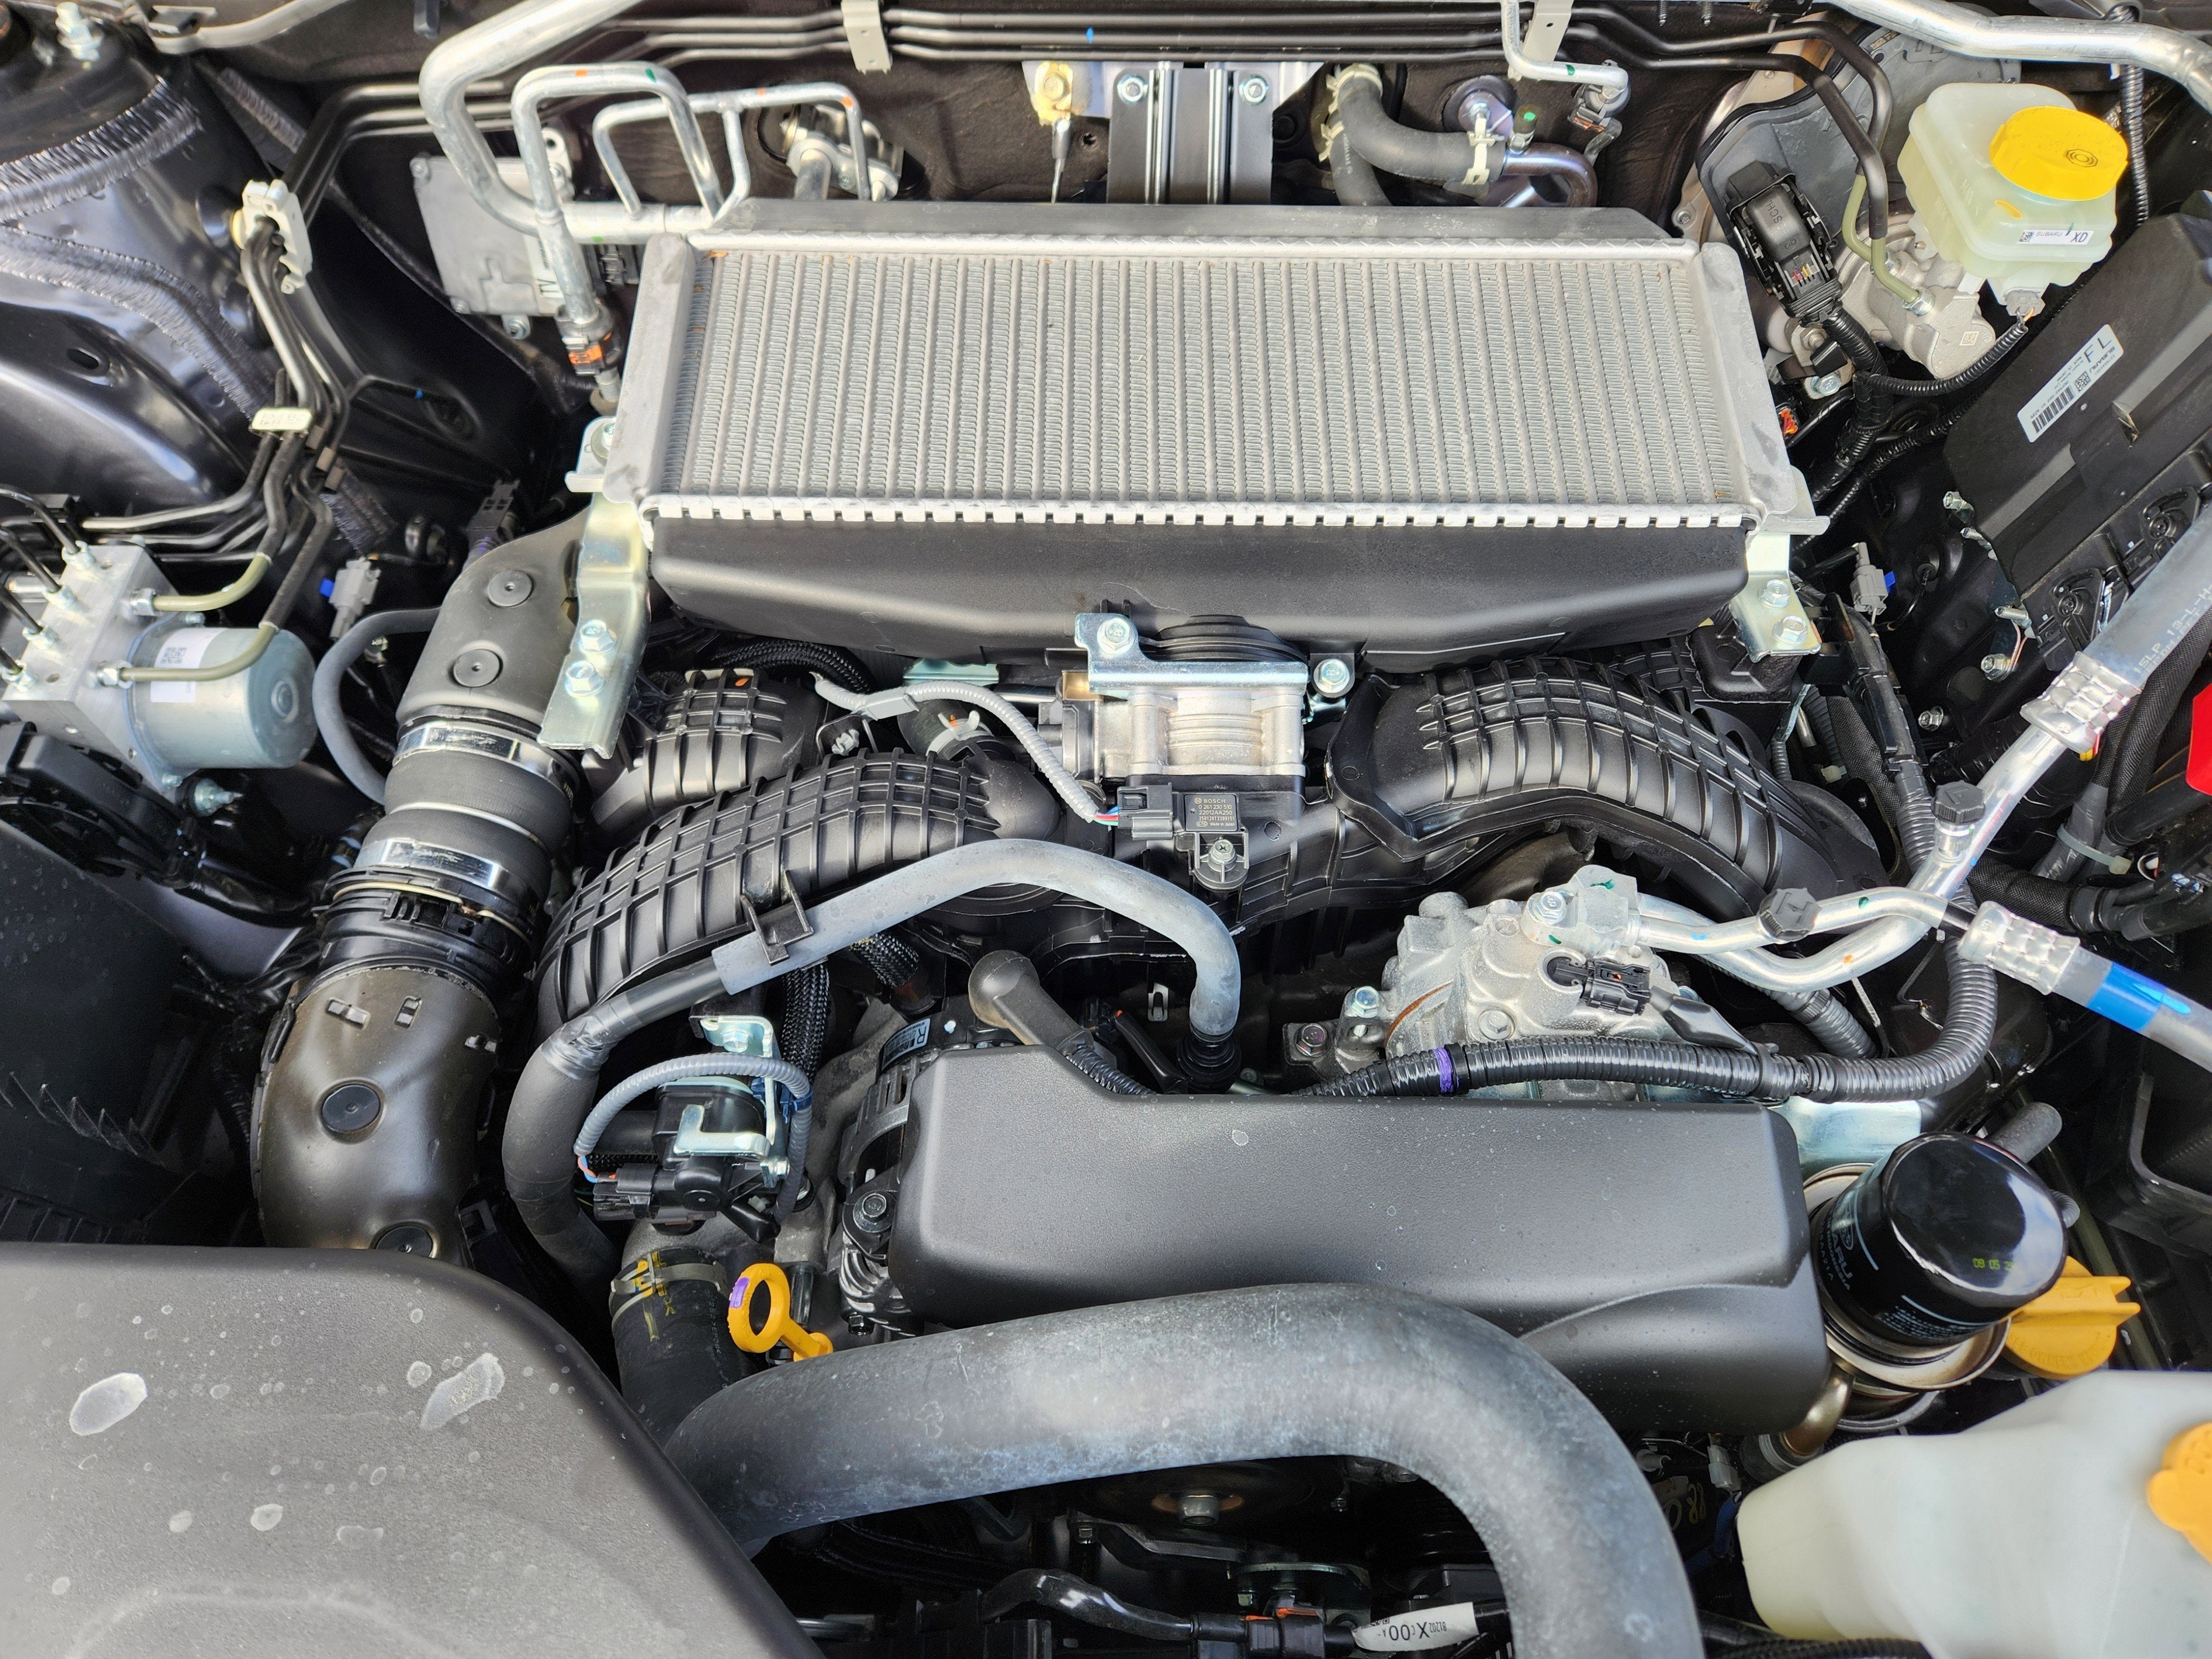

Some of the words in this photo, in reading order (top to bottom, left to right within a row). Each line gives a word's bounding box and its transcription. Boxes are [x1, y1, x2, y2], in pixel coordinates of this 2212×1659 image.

[2070, 232, 2088, 243] XD
[2090, 346, 2115, 373] SUBARU
[917, 1026, 927, 1044] R
